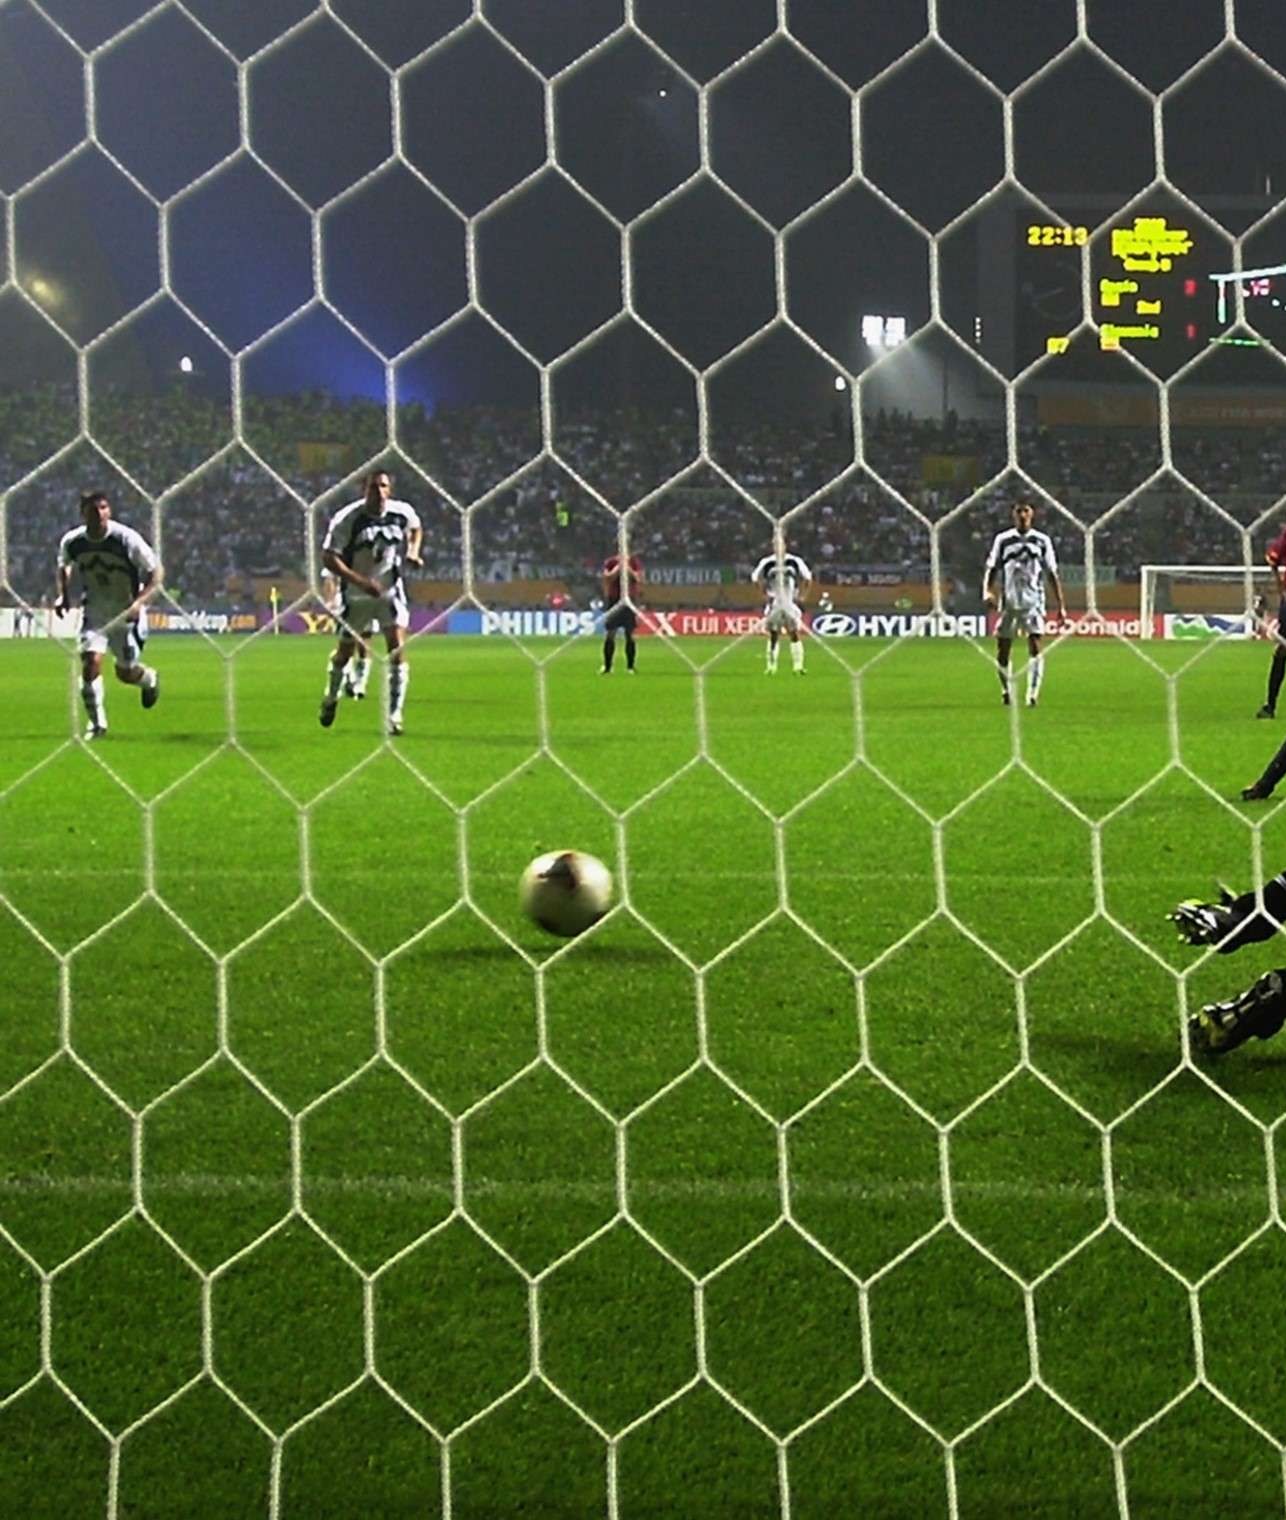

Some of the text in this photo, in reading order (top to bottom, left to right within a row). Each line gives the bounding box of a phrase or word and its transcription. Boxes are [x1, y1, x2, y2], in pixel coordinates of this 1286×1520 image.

[1027, 226, 1088, 246] 22:13
[481, 611, 596, 635] PHILIPS
[682, 615, 720, 634] FUJI
[858, 614, 987, 637] HYUNDAI
